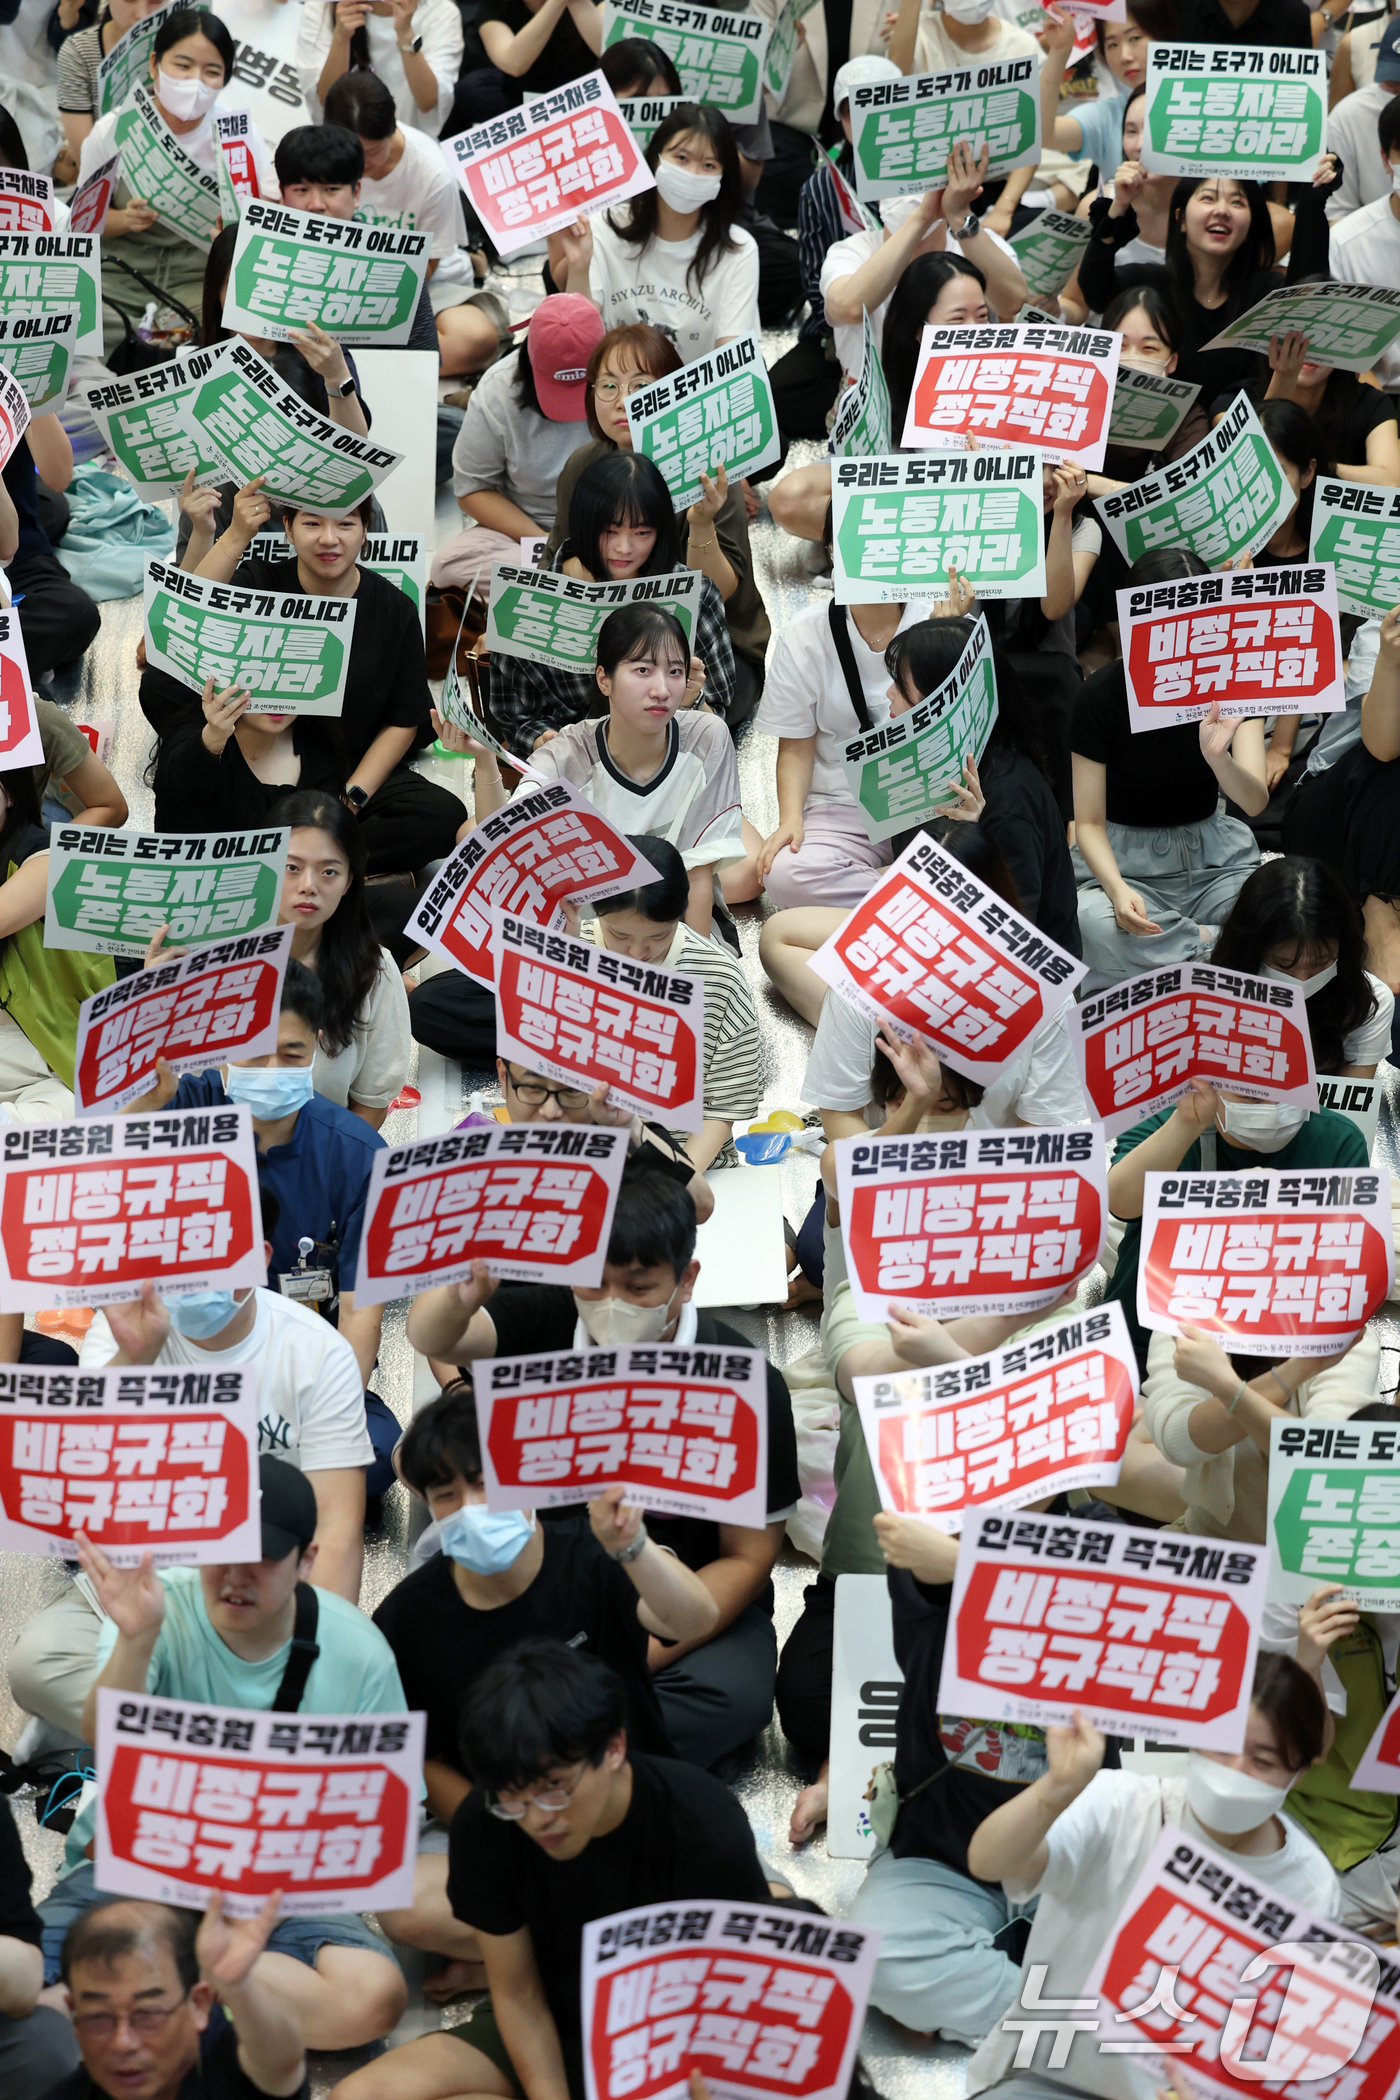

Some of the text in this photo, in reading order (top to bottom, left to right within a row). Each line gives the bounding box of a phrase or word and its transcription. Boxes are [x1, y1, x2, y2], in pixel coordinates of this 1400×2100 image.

[656, 7, 764, 41] 도구가 아니다
[233, 42, 304, 109] 병동
[855, 84, 911, 108] 우리는
[916, 73, 972, 98] 도구가
[976, 60, 1033, 91] 아니다
[1151, 48, 1320, 76] 우리는 도구가 아니다
[453, 77, 603, 162] 인력충원 즉각채용
[875, 90, 1020, 146] 노동자를
[1164, 80, 1307, 119] 노동자를
[133, 89, 201, 178] 우리는 도구가
[479, 109, 611, 197] 비정규직
[1163, 118, 1308, 158] 존중하라
[496, 143, 625, 227] 정규직화
[34, 236, 93, 258] 아니다
[246, 205, 426, 256] 우리는 도구가 아니다
[1040, 213, 1086, 238] 우리는
[252, 241, 405, 296] 노동자를
[1313, 284, 1373, 299] 도구가
[12, 313, 72, 340] 아니다
[246, 277, 398, 327] 존중하라
[610, 285, 712, 322] SIYAZU ARCHIVE
[1253, 301, 1399, 332] 노동자를
[929, 328, 1114, 358] 인력충원 즉각채용
[86, 360, 188, 411] 우리는 도구가
[556, 369, 587, 381] emis
[630, 337, 757, 422] 우리는 도구가 아니다
[934, 357, 1097, 403] 비정규직
[1132, 374, 1195, 400] 아니다
[219, 381, 368, 488] 노동자를
[227, 344, 399, 469] 우리는 도구가 아니다
[651, 374, 756, 461] 노동자를
[927, 394, 1088, 442] 정규직화
[201, 406, 347, 506] 존중하라
[837, 454, 1036, 487] 우리는 도구가 아니다
[1103, 398, 1250, 519] 우리는 도구가 아니다
[856, 487, 1021, 535] 노동자를
[1137, 437, 1260, 546] 노동자를
[1320, 484, 1385, 515] 우리는
[359, 539, 419, 562] 아니다
[859, 533, 1023, 577] 존중하라
[148, 560, 349, 622] 우리는 도구가 아니다
[497, 565, 697, 604] 우리는 도구가 아니다
[1129, 568, 1327, 615] 인력충원 즉각채용
[162, 601, 329, 662] 노동자를
[1148, 598, 1316, 664] 비정규직
[165, 635, 325, 694] 존중하라
[844, 625, 989, 762] 우리는 도구가 아니다
[1153, 647, 1321, 701] 정규직화
[877, 669, 992, 790] 노동자를
[1185, 705, 1256, 722] 전국보건산업노동조합
[57, 829, 283, 861] 우리는 도구가 아니다
[416, 785, 573, 939] 인력충원 즉각채용
[74, 863, 261, 904] 노동자를
[452, 812, 591, 951] 비정규직
[72, 898, 258, 940] 존중하라
[906, 842, 1077, 988] 인력충원 즉각채용
[88, 930, 286, 1023] 인력충원 즉각채용
[503, 917, 695, 1007] 인력충원 즉각채용
[874, 883, 1038, 1022] 비정규직
[101, 963, 265, 1061] 비정규직
[516, 959, 681, 1056] 비정규직
[845, 922, 1003, 1055] 정규직화
[1081, 968, 1295, 1032] 인력충원 즉각채용
[95, 999, 257, 1098] 정규직화
[518, 1005, 679, 1100] 정규직화
[1104, 1000, 1284, 1070] 비정규직
[1113, 1039, 1291, 1107] 정규직화
[4, 1112, 240, 1161] 인력충원 즉각채용
[383, 1129, 618, 1179] 인력충원 즉각채용
[851, 1130, 1094, 1176] 인력충원 즉각채용
[22, 1158, 228, 1225] 비정규직
[391, 1166, 594, 1231] 비정규직
[872, 1175, 1080, 1240] 비정규직
[1156, 1175, 1380, 1209] 인력충원 즉각채용
[26, 1211, 234, 1277] 정규직화
[384, 1204, 583, 1272] 정규직화
[876, 1227, 1084, 1292] 정규직화
[1168, 1220, 1366, 1272] 비정규직
[1167, 1271, 1369, 1323] 정규직화
[490, 1348, 754, 1390] 인력충원 즉각채용
[1001, 1311, 1113, 1376] 즉각채용
[0, 1371, 243, 1407] 인력충원 즉각채용
[513, 1386, 738, 1441] 비정규직
[901, 1357, 1108, 1464] 비정규직
[11, 1419, 227, 1476] 비정규직
[516, 1430, 739, 1490] 정규직화
[911, 1402, 1120, 1511] 정규직화
[1278, 1426, 1361, 1460] 우리는
[19, 1475, 229, 1532] 정규직화
[976, 1517, 1258, 1585] 인력충원 즉각채용
[984, 1570, 1232, 1652] 비정규직
[977, 1625, 1222, 1711] 정규직화
[115, 1702, 411, 1757] 인력충원 즉각채용
[130, 1753, 389, 1822] 비정규직
[131, 1810, 385, 1882] 정규직화
[1163, 1842, 1298, 1943] 인력충원
[596, 1909, 868, 1964] 인력충원 즉각채용
[606, 1957, 839, 2037] 비정규직
[608, 2011, 824, 2099] 정규직화
